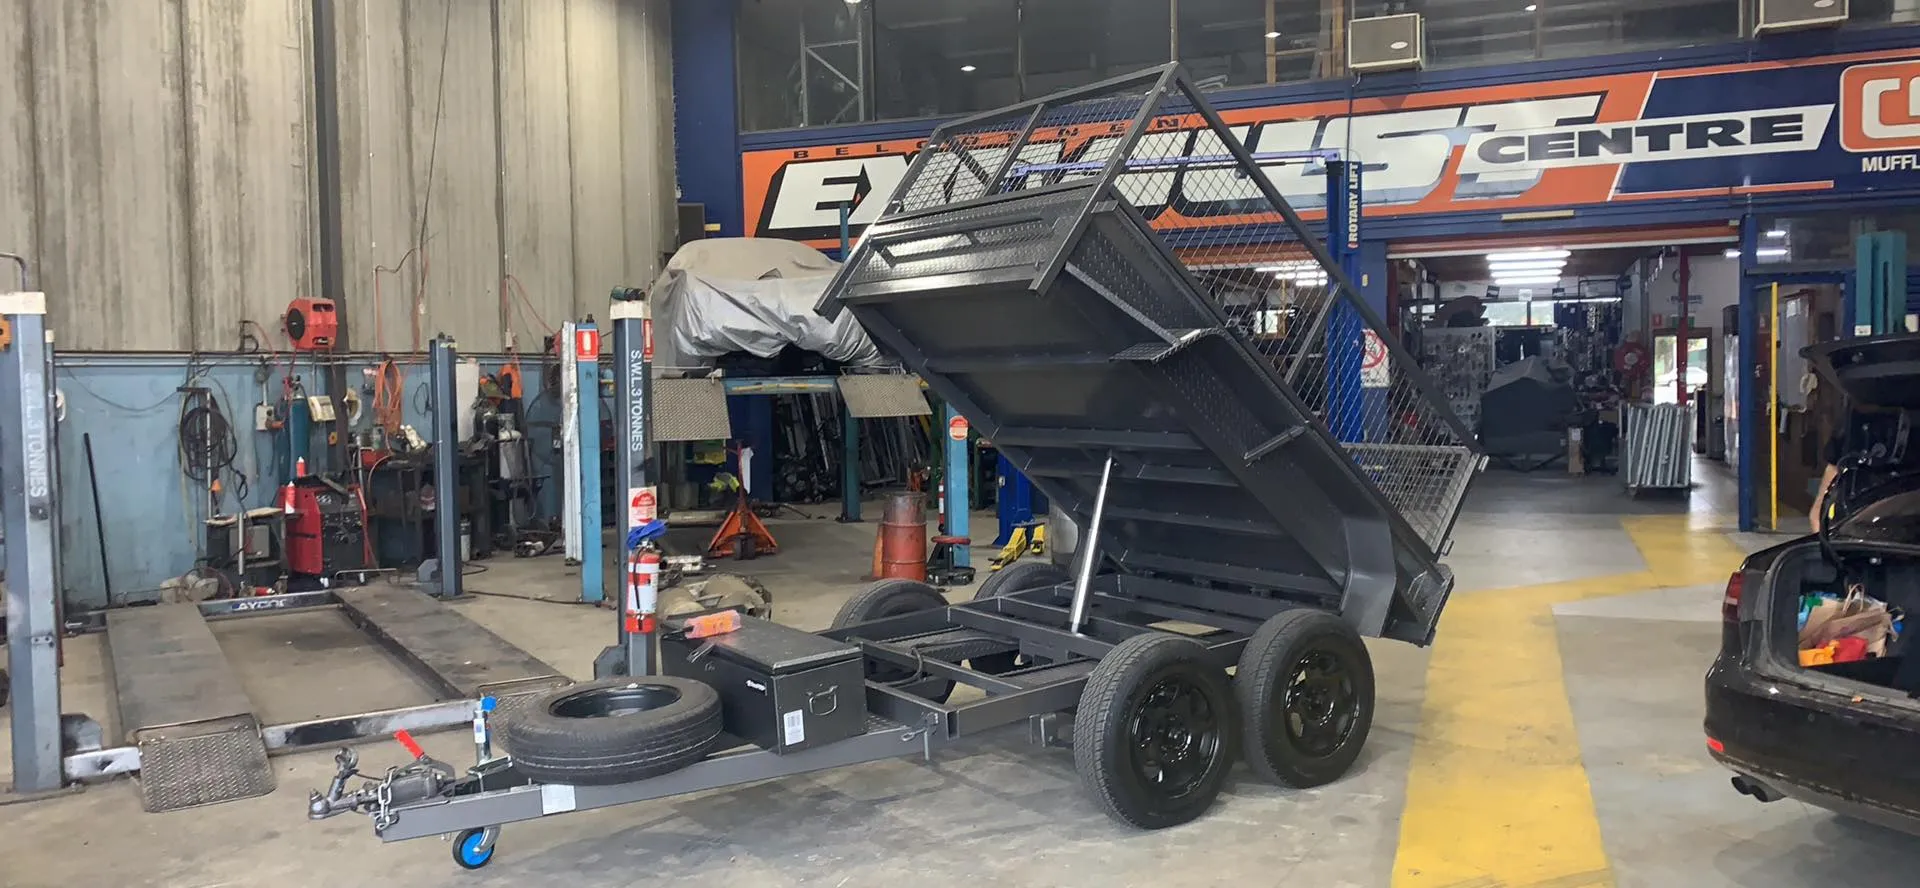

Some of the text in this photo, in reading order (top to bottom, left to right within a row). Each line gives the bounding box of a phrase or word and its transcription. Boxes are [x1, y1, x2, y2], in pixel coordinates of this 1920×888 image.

[1477, 113, 1804, 164] CENTRE
[1348, 162, 1359, 242] ROTARY LIFT
[631, 388, 643, 397] 3
[631, 397, 644, 452] TONNES
[27, 430, 48, 498] TONNES
